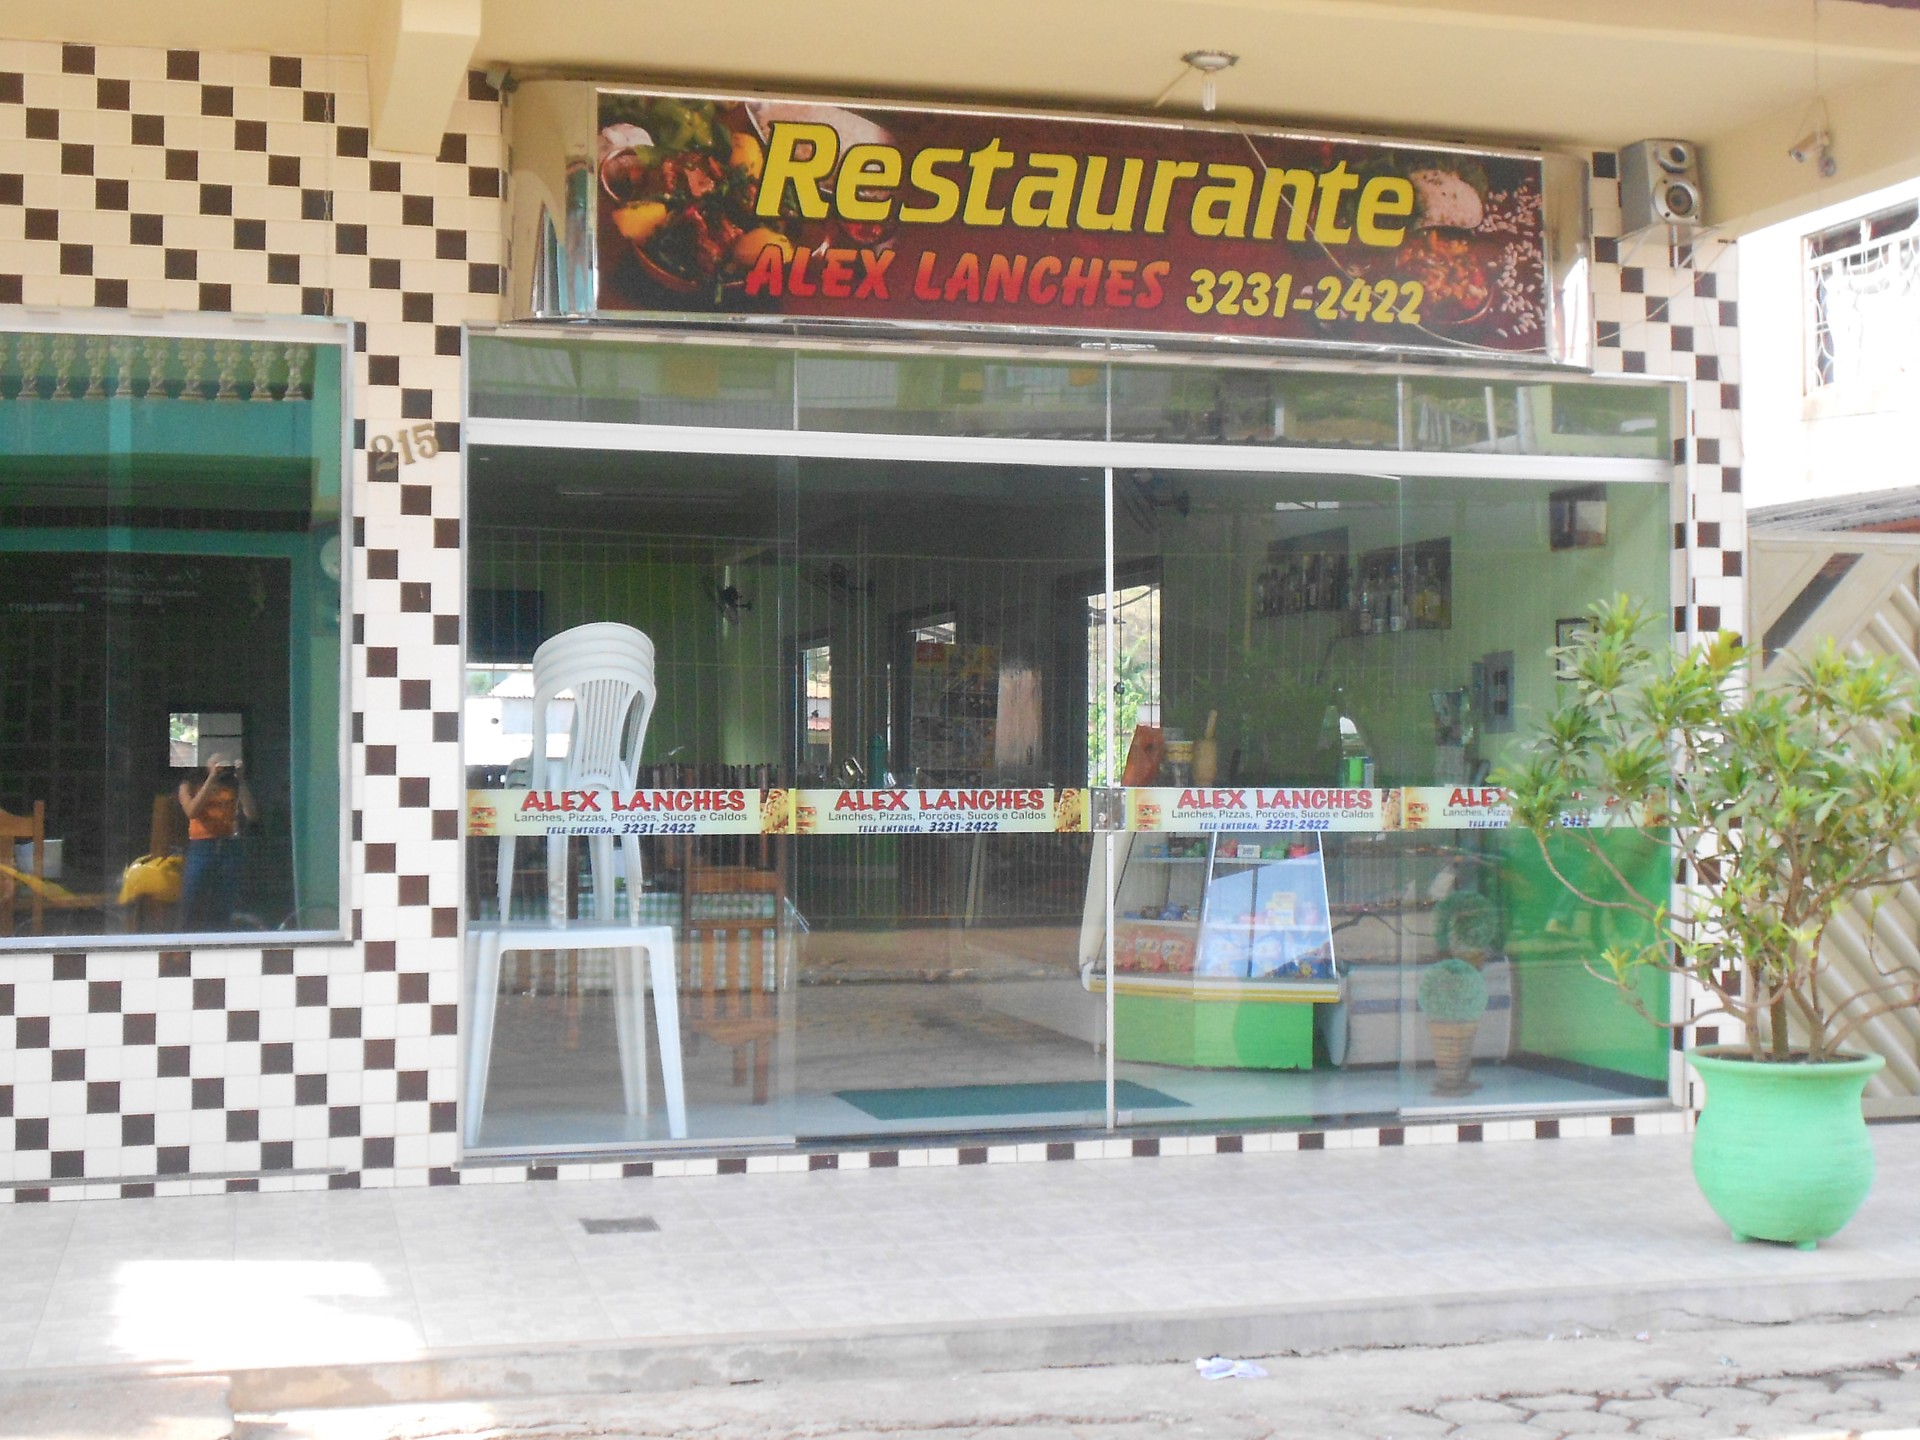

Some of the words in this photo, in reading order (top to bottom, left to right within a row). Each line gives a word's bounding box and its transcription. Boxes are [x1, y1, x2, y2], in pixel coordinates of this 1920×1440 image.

[755, 121, 1415, 247] Restaurante
[745, 243, 896, 300] ALEX
[914, 250, 1171, 310] LANCHES
[1186, 268, 1425, 325] 3231-2422
[370, 422, 439, 473] 215
[520, 790, 599, 812] ALEX
[612, 790, 747, 812] LANCHES
[834, 790, 910, 811] ALEX
[919, 790, 1045, 811] LANCHES
[1176, 789, 1247, 810] ALEX
[1255, 789, 1373, 810] LANCHES
[514, 812, 565, 823] Lanches,
[568, 812, 607, 824] Pizzas,
[610, 812, 660, 824] Porções,
[662, 811, 697, 822] Sucos
[699, 813, 707, 822] e
[709, 811, 748, 822] Caldos
[828, 811, 876, 822] Lanches,
[879, 811, 916, 823] Pizzas,
[918, 811, 965, 823] Porções,
[967, 810, 1000, 821] Sucos
[1002, 812, 1009, 820] e
[1011, 810, 1047, 820] Caldos
[1171, 809, 1216, 820] Lanches,
[1218, 809, 1253, 820] Pizzas,
[1255, 809, 1299, 820] Porções,
[1300, 809, 1331, 819] Sucos
[1341, 809, 1375, 819] Caldos
[1442, 808, 1485, 818] Lanches,
[621, 823, 696, 834] 3231-2422
[929, 821, 999, 833] 3231-2422
[1265, 819, 1330, 830] 3231-2422
